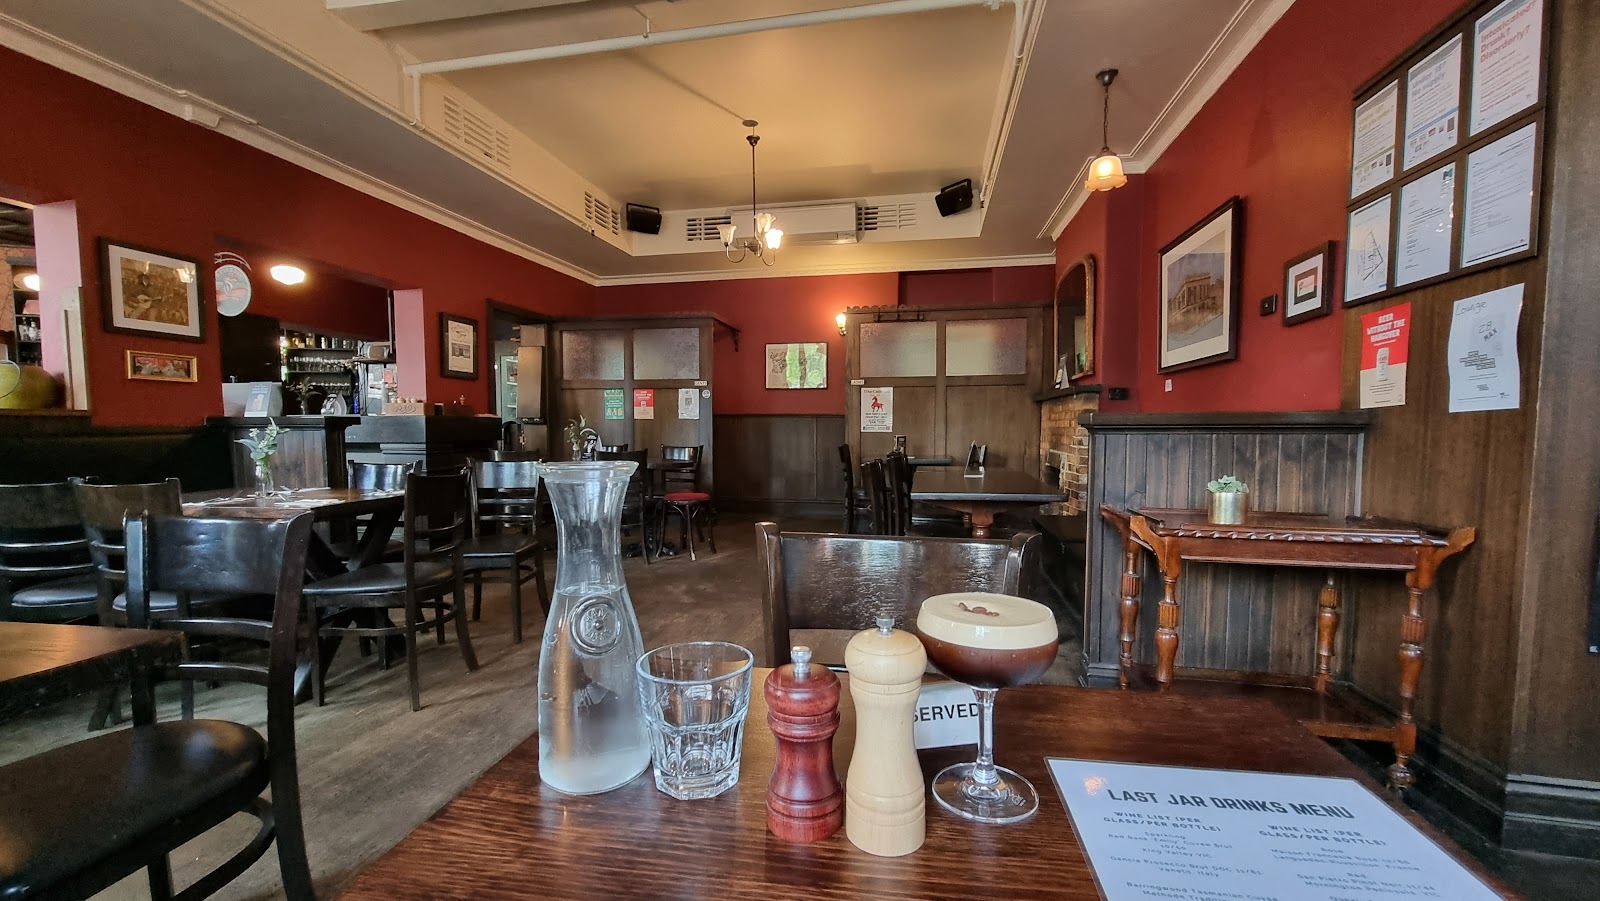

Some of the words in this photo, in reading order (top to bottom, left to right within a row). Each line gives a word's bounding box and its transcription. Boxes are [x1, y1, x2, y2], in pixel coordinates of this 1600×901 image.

[1481, 27, 1510, 53] Drunk?
[1481, 24, 1530, 63] Disorderly?
[1455, 302, 1487, 316] Lounge
[1484, 327, 1498, 341] MAX
[914, 703, 978, 722] ERVED
[1107, 789, 1159, 803] LAST
[1168, 793, 1208, 807] JAR
[1209, 796, 1288, 813] DRINKS
[1288, 802, 1355, 819] MENU
[1114, 811, 1143, 819] WINE
[1103, 816, 1168, 827] GLASS/PER
[1172, 822, 1221, 832] BOTTLE)
[1304, 827, 1329, 835] LIST
[1258, 830, 1329, 842] GLASS/PER
[1334, 836, 1387, 846] BOTTLE)
